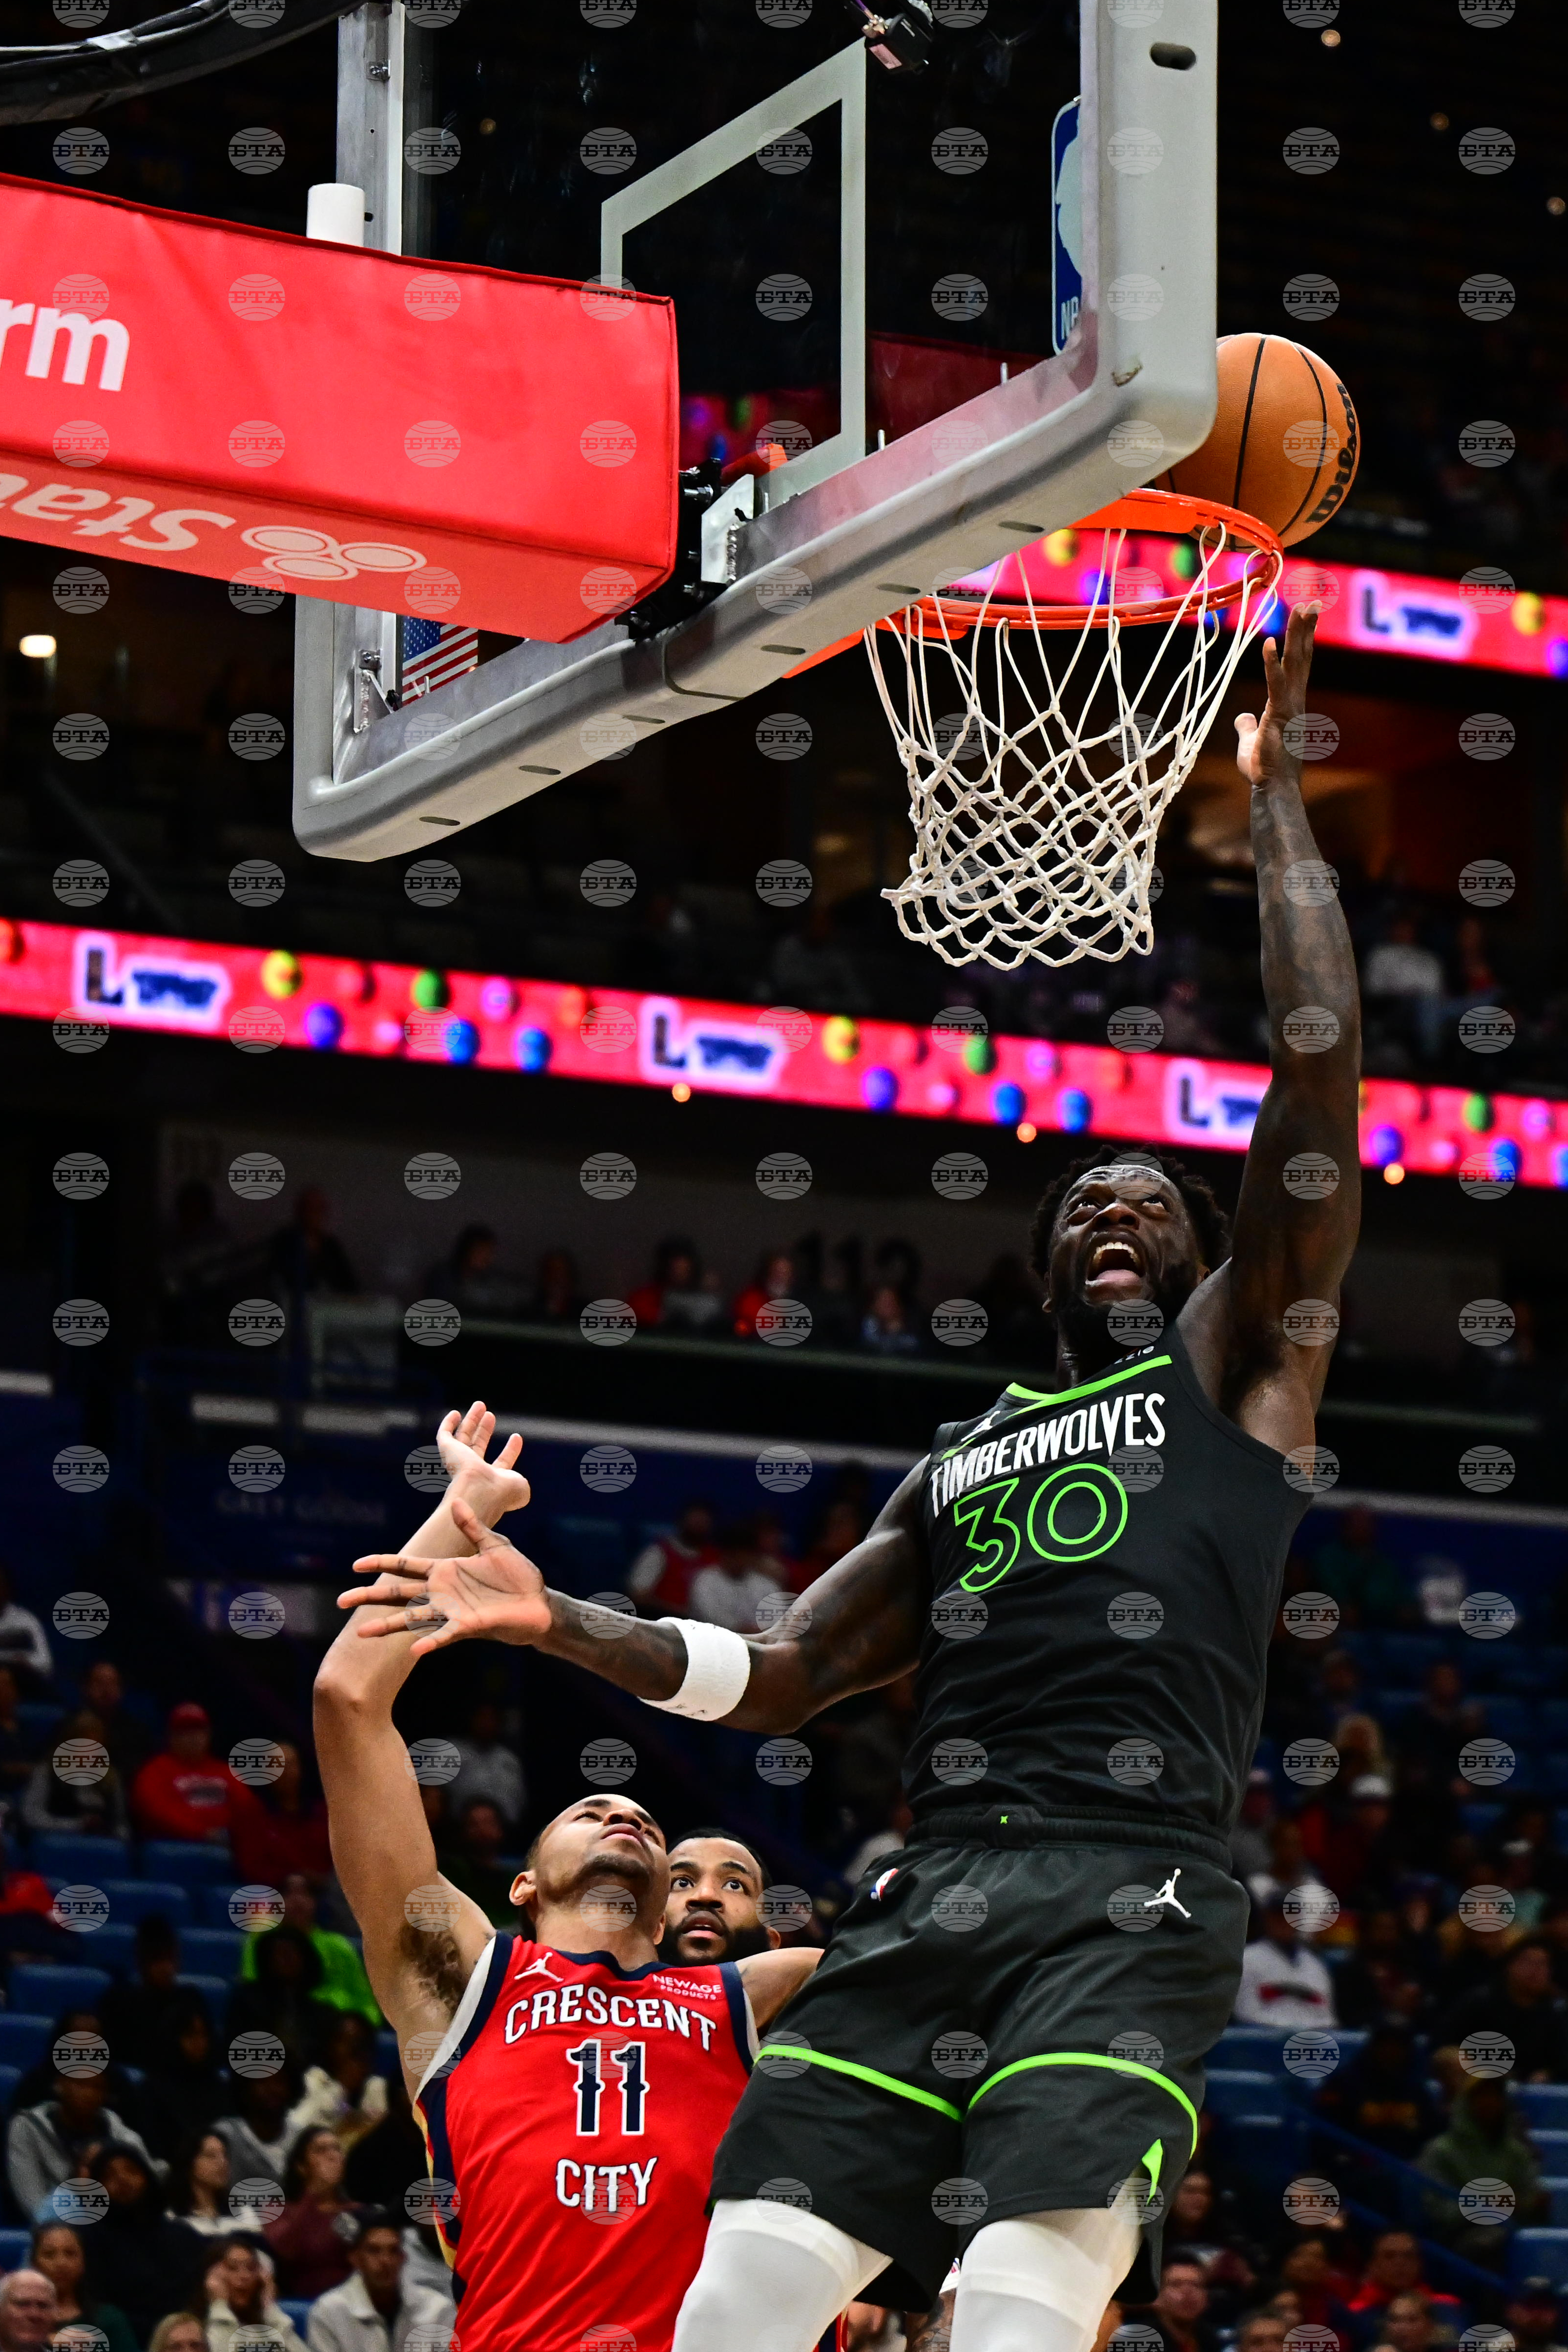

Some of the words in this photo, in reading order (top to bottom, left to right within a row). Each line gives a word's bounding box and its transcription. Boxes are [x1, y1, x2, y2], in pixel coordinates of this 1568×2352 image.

[1061, 296, 1079, 340] NB
[929, 1393, 1165, 1518] TIMBERWOLVES
[954, 1463, 1128, 1592] 30
[652, 1974, 722, 1994] NEWAGE
[660, 1984, 717, 2000] PRODUCTS
[504, 1983, 717, 2051] CRESCENT
[565, 2039, 651, 2136] 11
[556, 2157, 658, 2213] CITY
